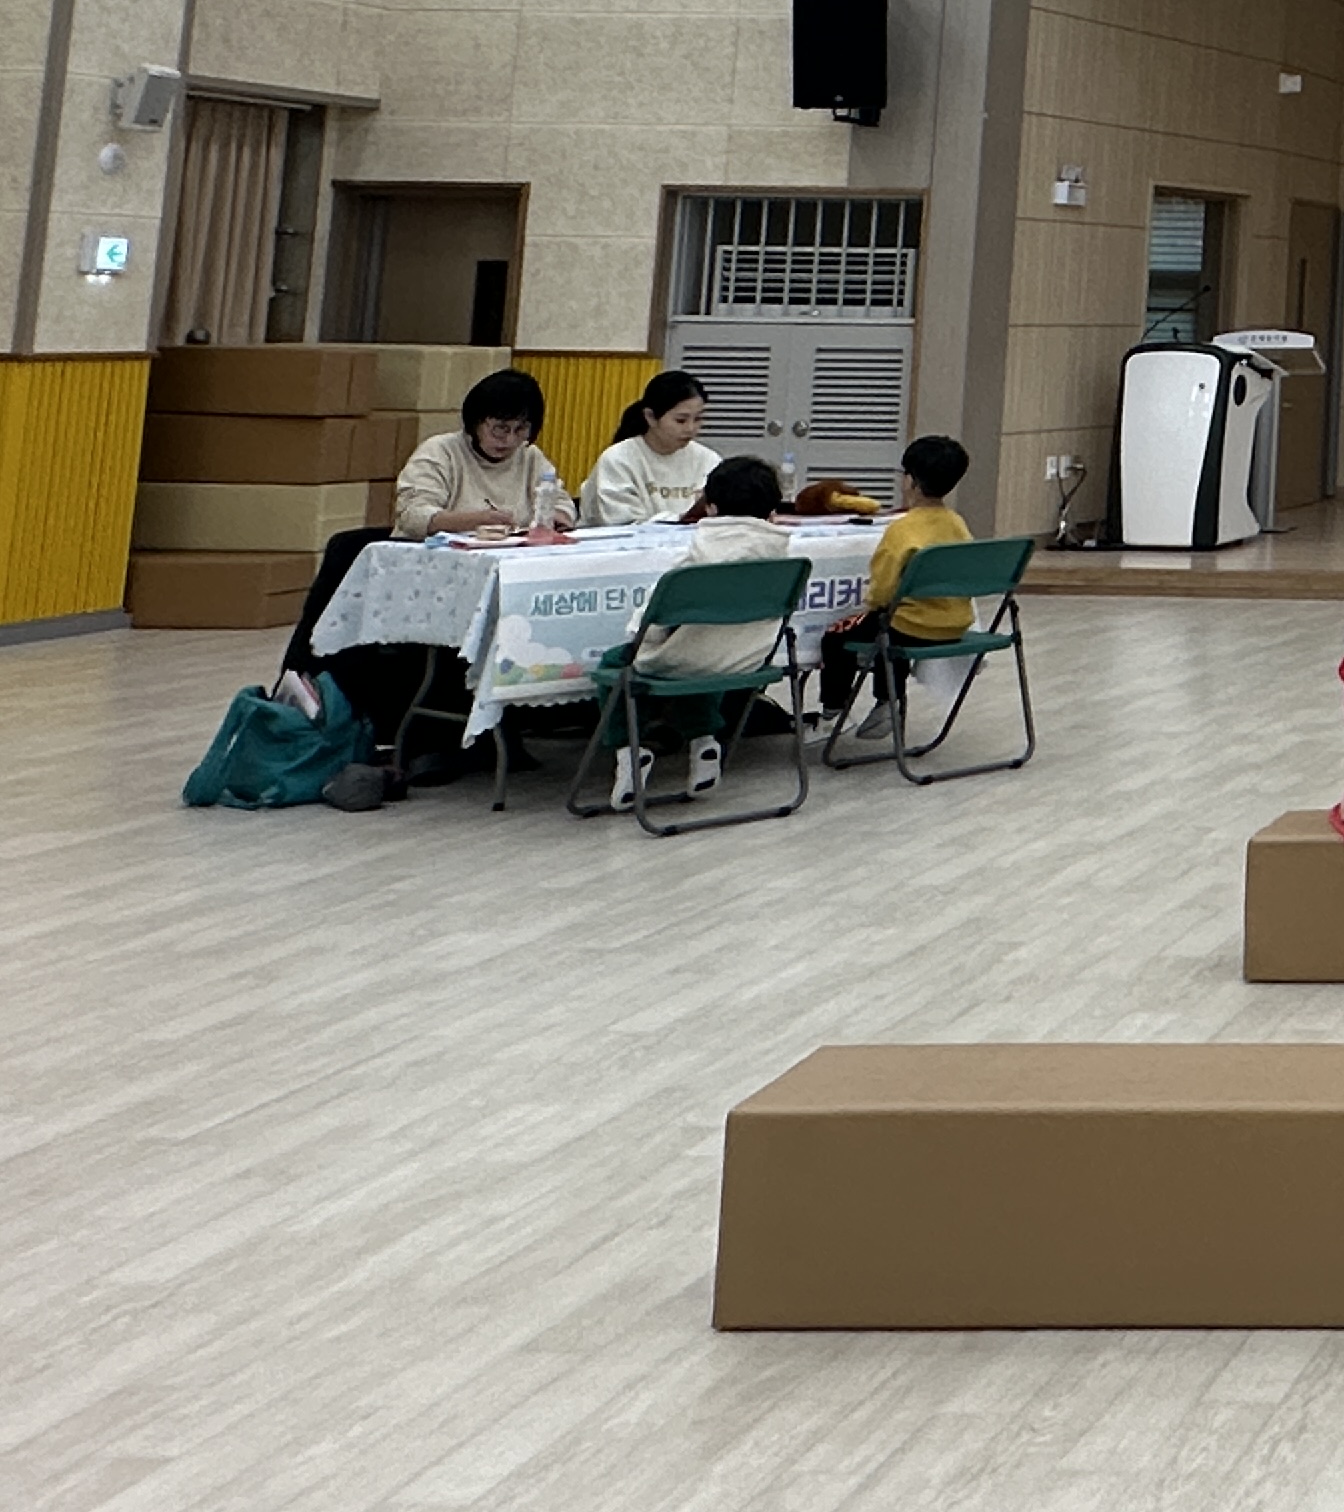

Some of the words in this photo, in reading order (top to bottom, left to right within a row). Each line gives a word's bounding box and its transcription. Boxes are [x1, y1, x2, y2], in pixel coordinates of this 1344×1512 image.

[530, 589, 599, 618] 세상에
[604, 587, 627, 611] 단
[798, 576, 871, 612] 리커
